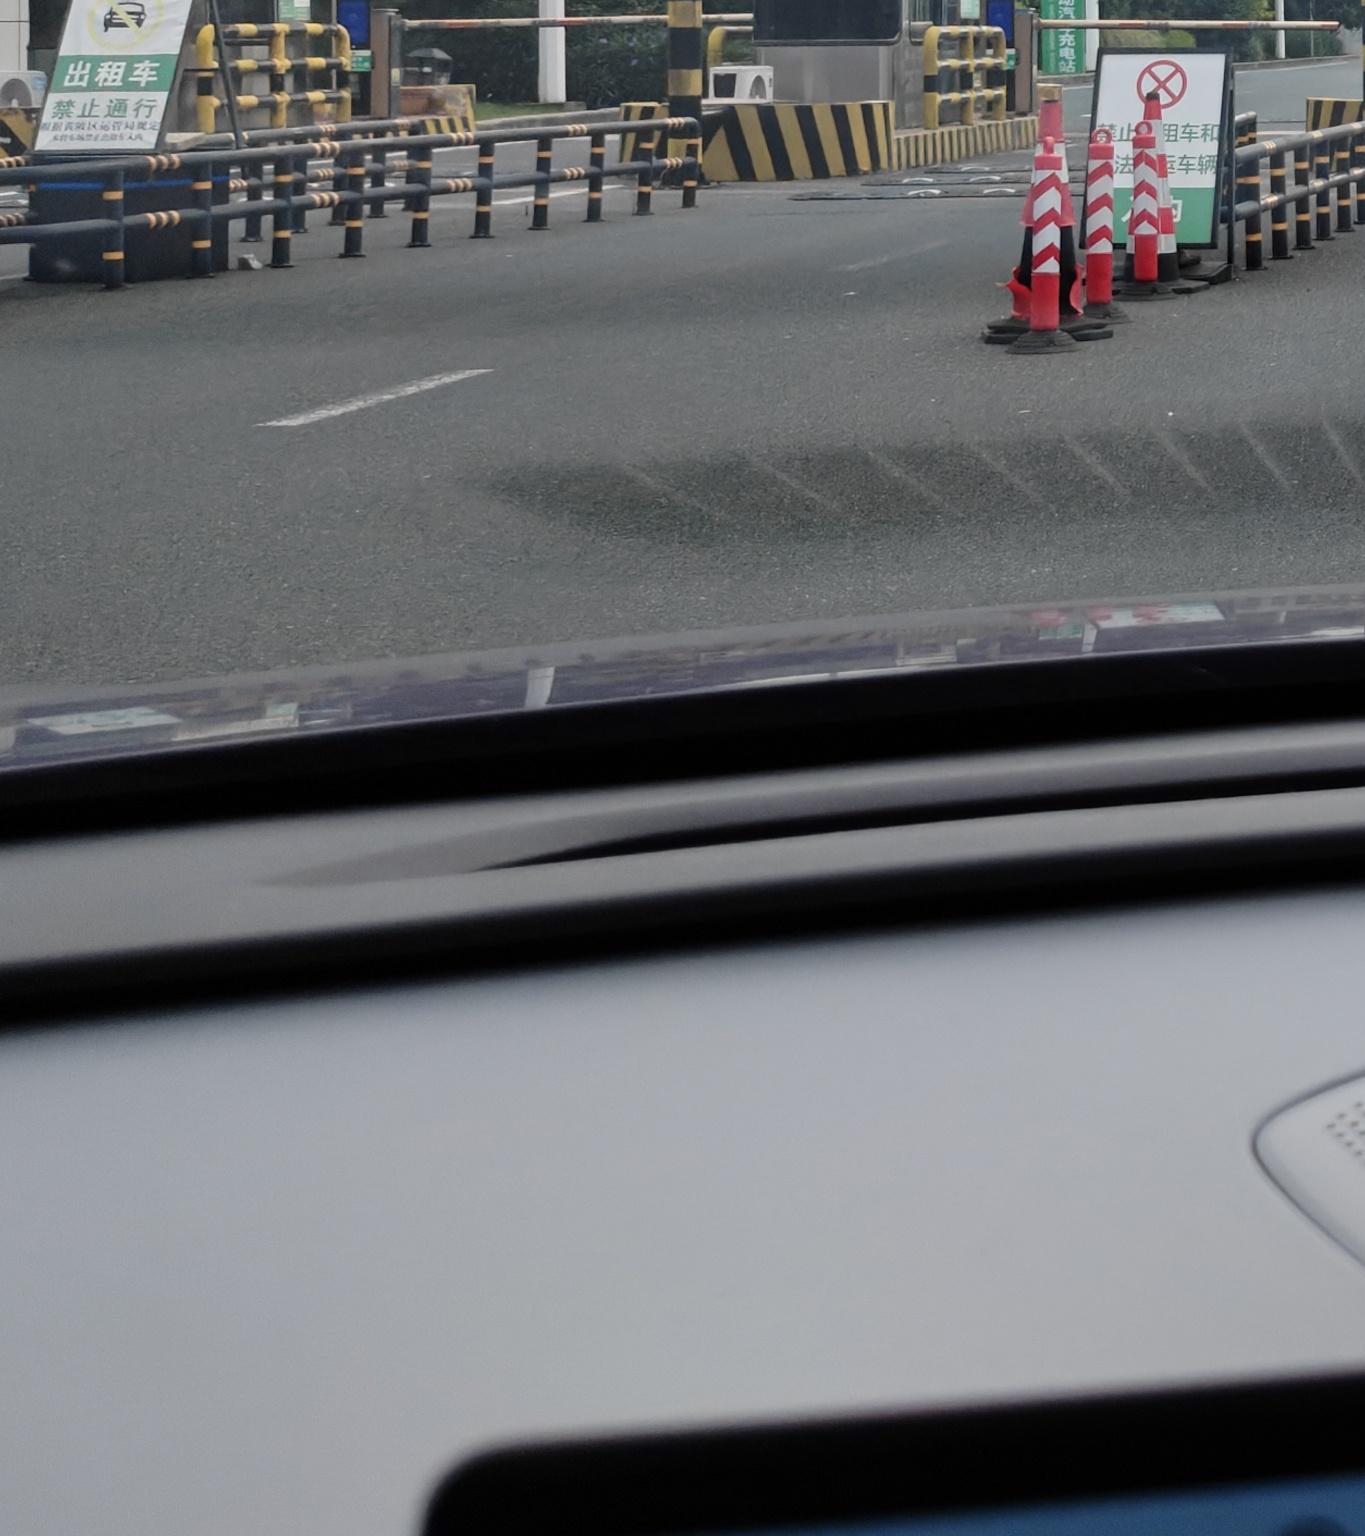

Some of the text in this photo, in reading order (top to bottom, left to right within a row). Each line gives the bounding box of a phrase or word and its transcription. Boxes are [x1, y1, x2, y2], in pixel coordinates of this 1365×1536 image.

[63, 60, 161, 87] 出租车
[51, 97, 157, 120] 禁止通行
